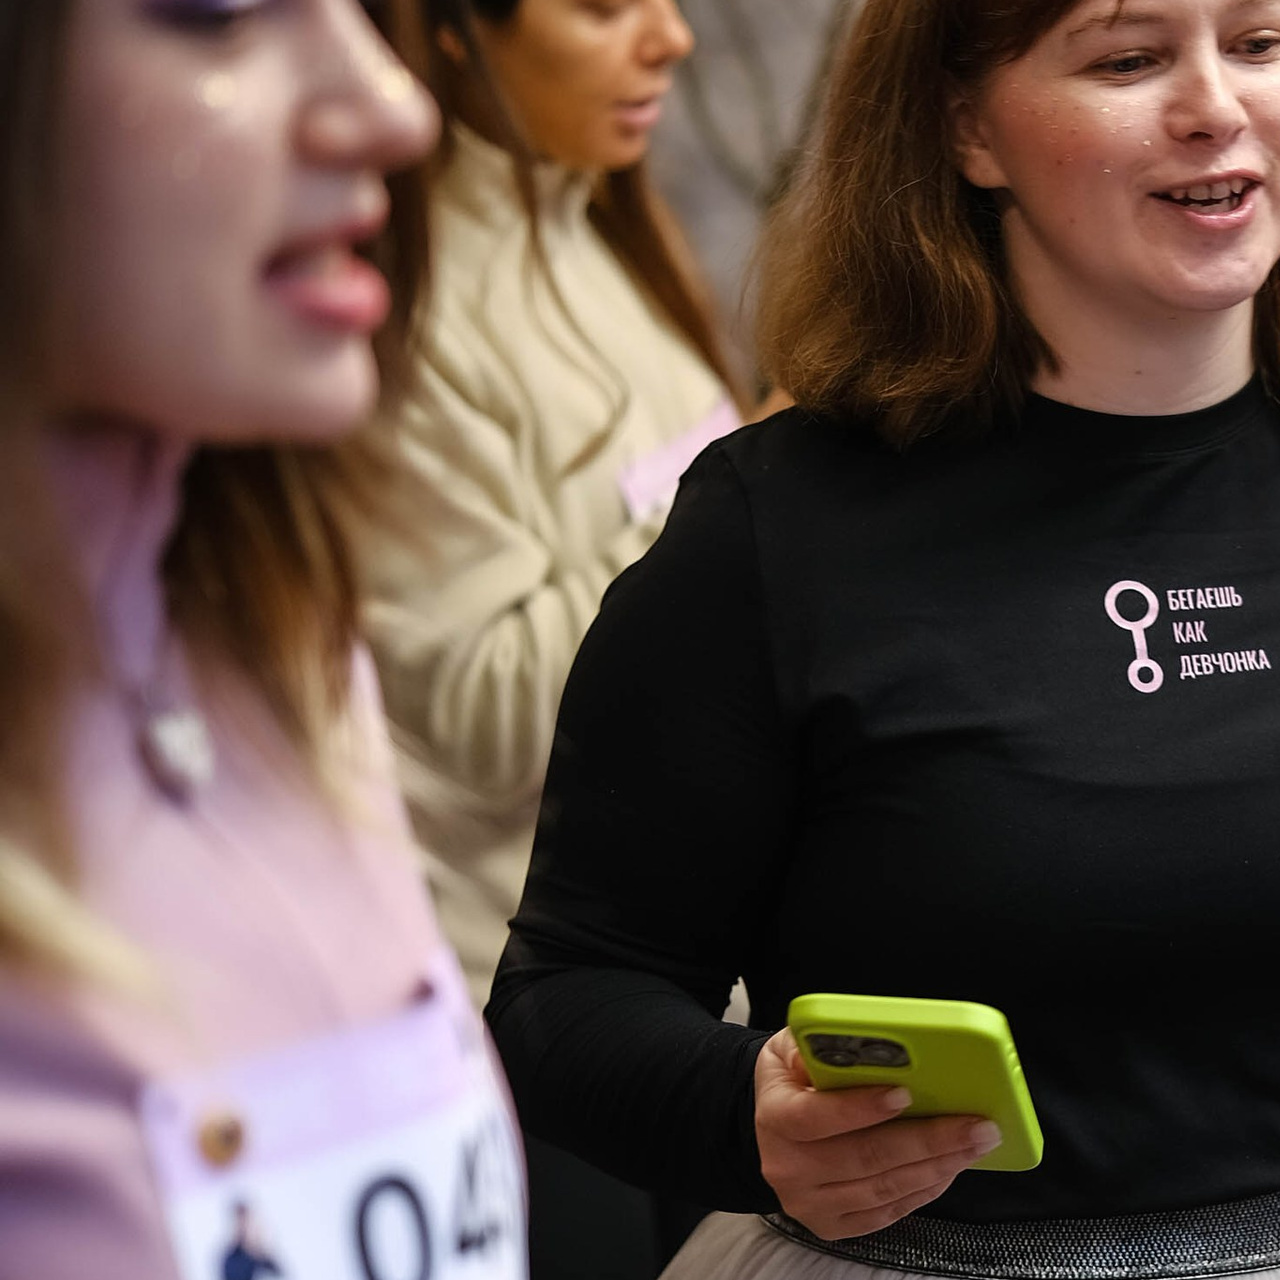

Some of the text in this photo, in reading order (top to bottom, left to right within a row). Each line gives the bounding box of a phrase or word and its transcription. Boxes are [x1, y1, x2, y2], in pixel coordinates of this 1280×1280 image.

[1166, 586, 1243, 611] БЕГАЕШЬ
[1172, 620, 1208, 644] КАК
[1180, 649, 1272, 680] ДЕВЧОНКА
